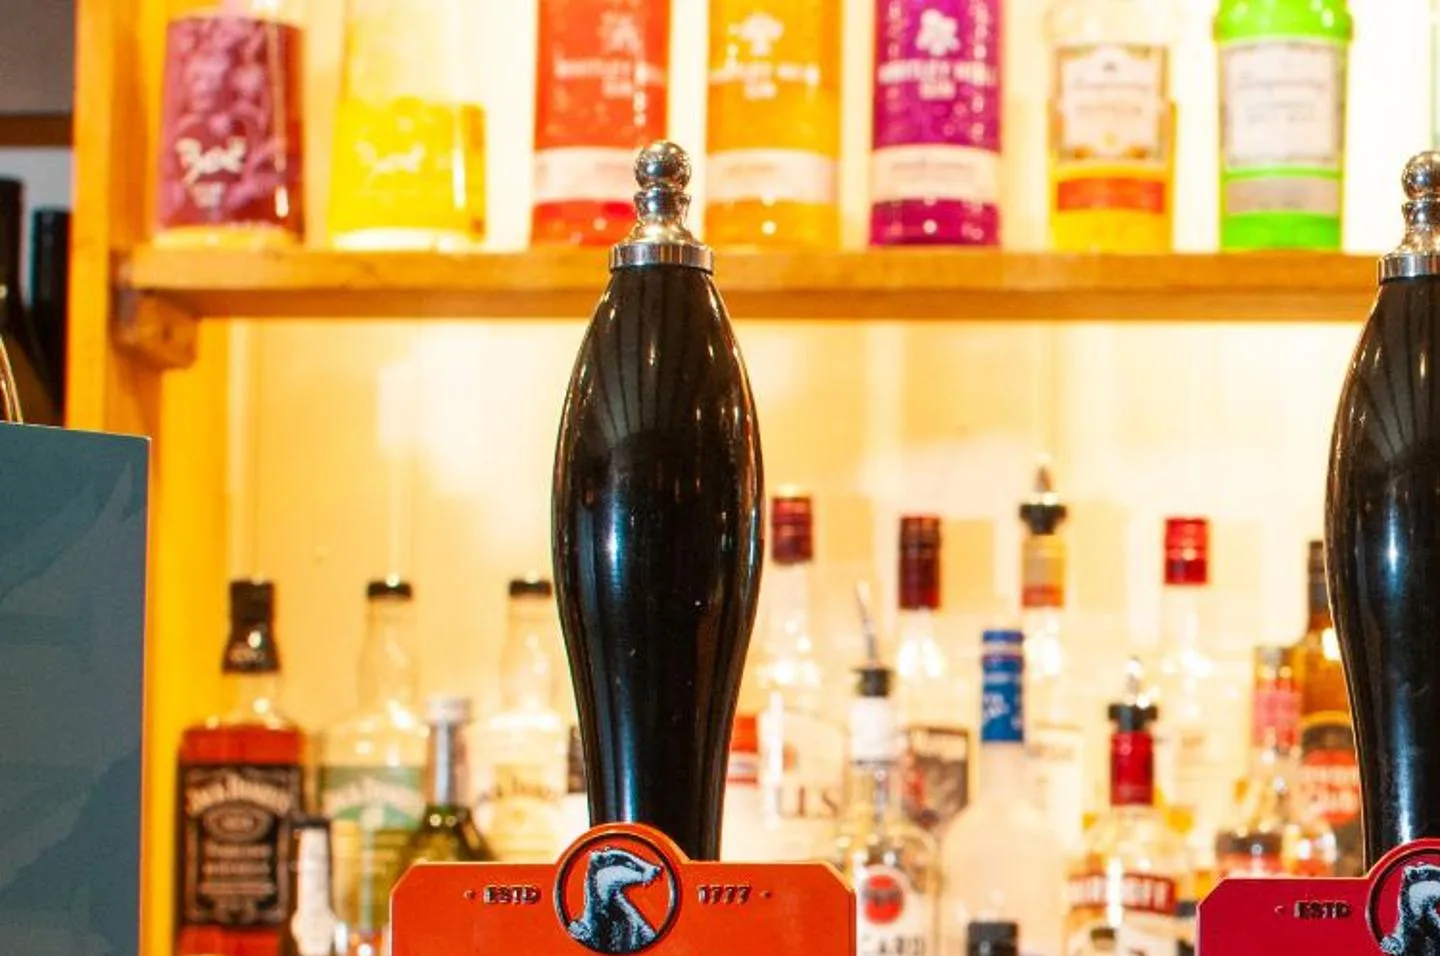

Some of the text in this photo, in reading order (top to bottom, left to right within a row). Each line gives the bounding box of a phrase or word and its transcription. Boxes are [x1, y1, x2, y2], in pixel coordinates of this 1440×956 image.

[483, 884, 751, 905] ESTD 1777
[1293, 901, 1352, 920] ESTD
